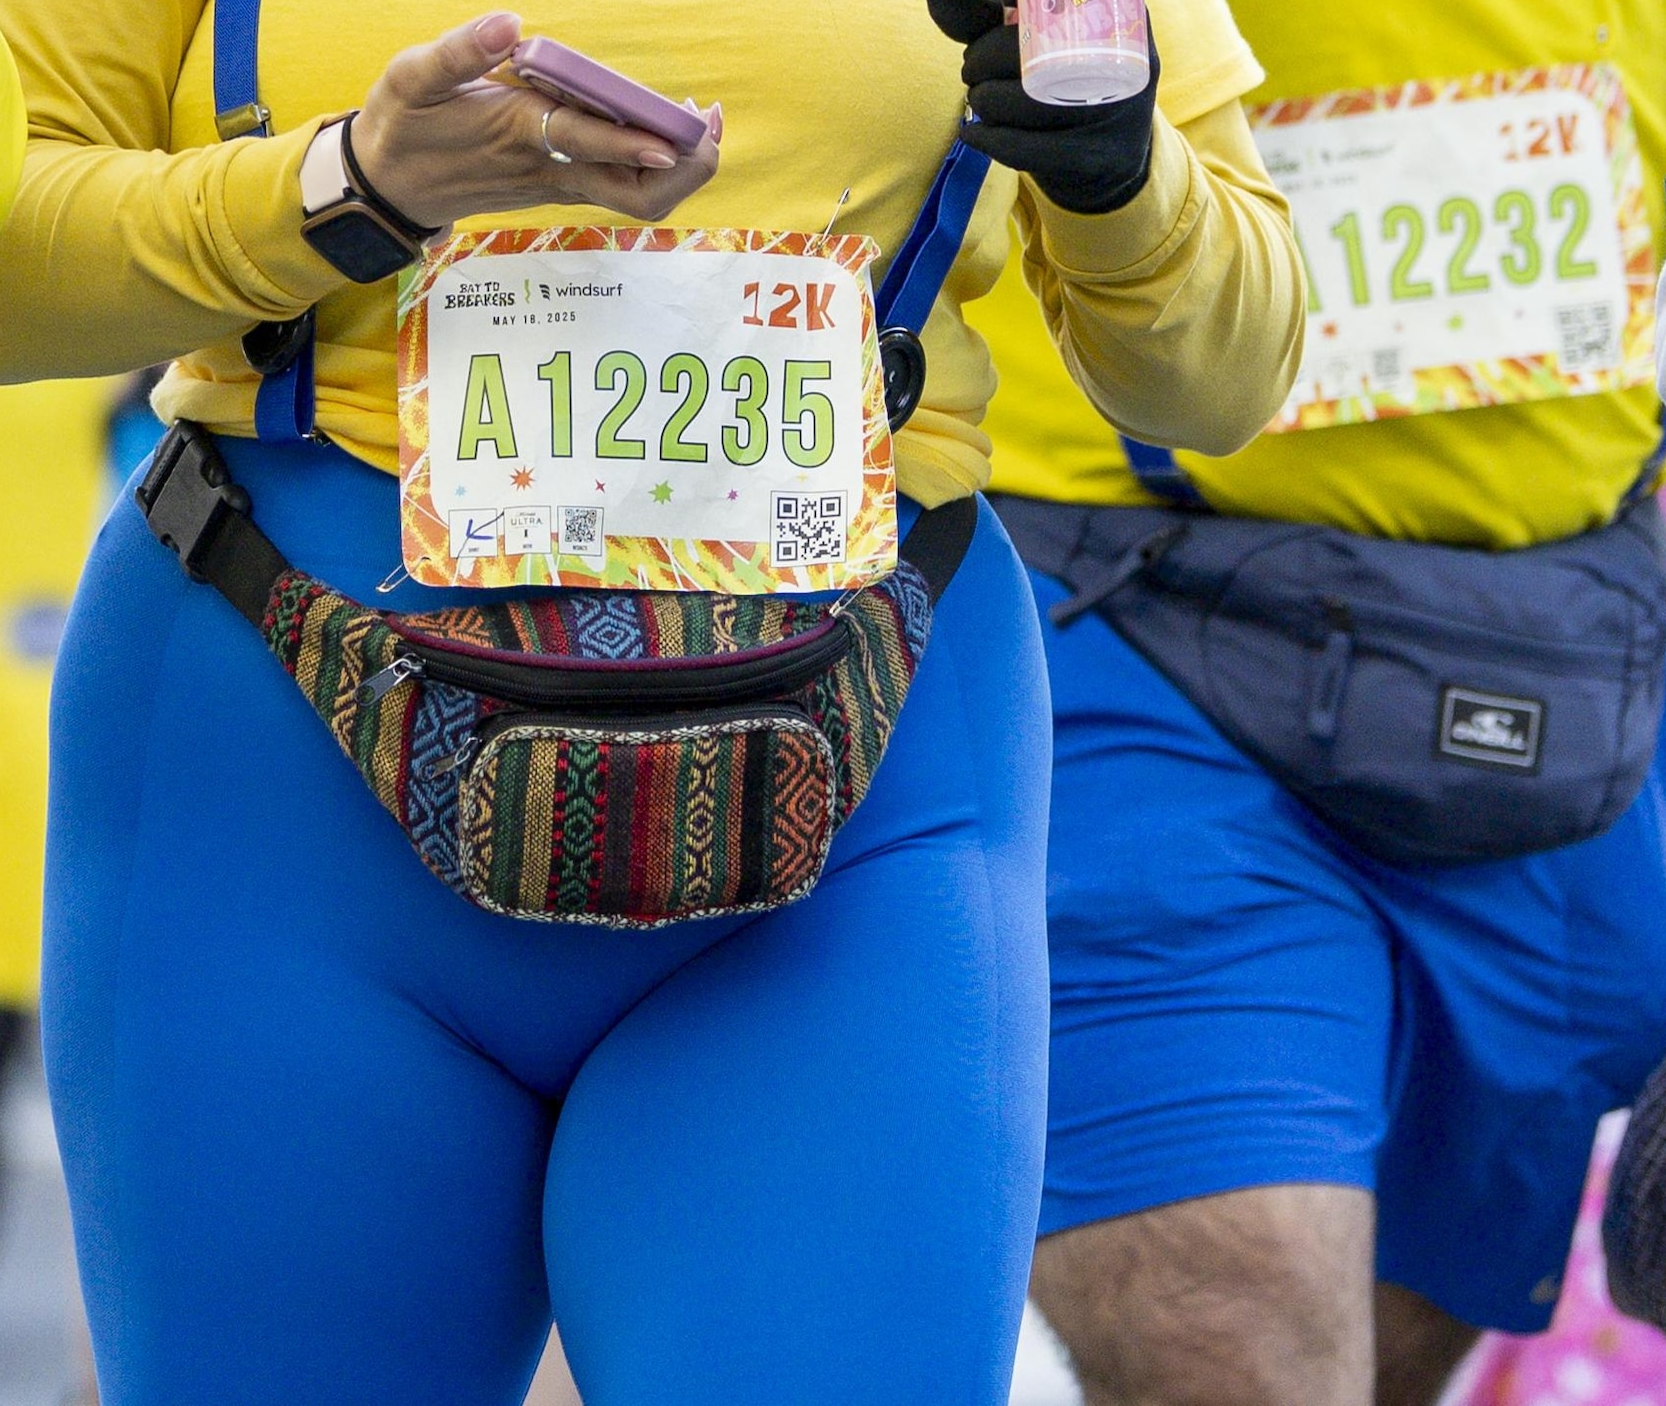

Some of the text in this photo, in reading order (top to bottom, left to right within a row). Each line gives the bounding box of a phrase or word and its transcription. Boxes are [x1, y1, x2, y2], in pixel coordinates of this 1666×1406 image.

[1293, 183, 1597, 313] 12232
[460, 282, 499, 293] BAY TO
[556, 283, 623, 297] windsurf
[445, 292, 515, 309] BREAKERS
[743, 282, 835, 331] 12K
[493, 316, 515, 325] MAY
[548, 311, 576, 322] 2025
[457, 350, 835, 468] A12235
[511, 518, 542, 526] ULTRA
